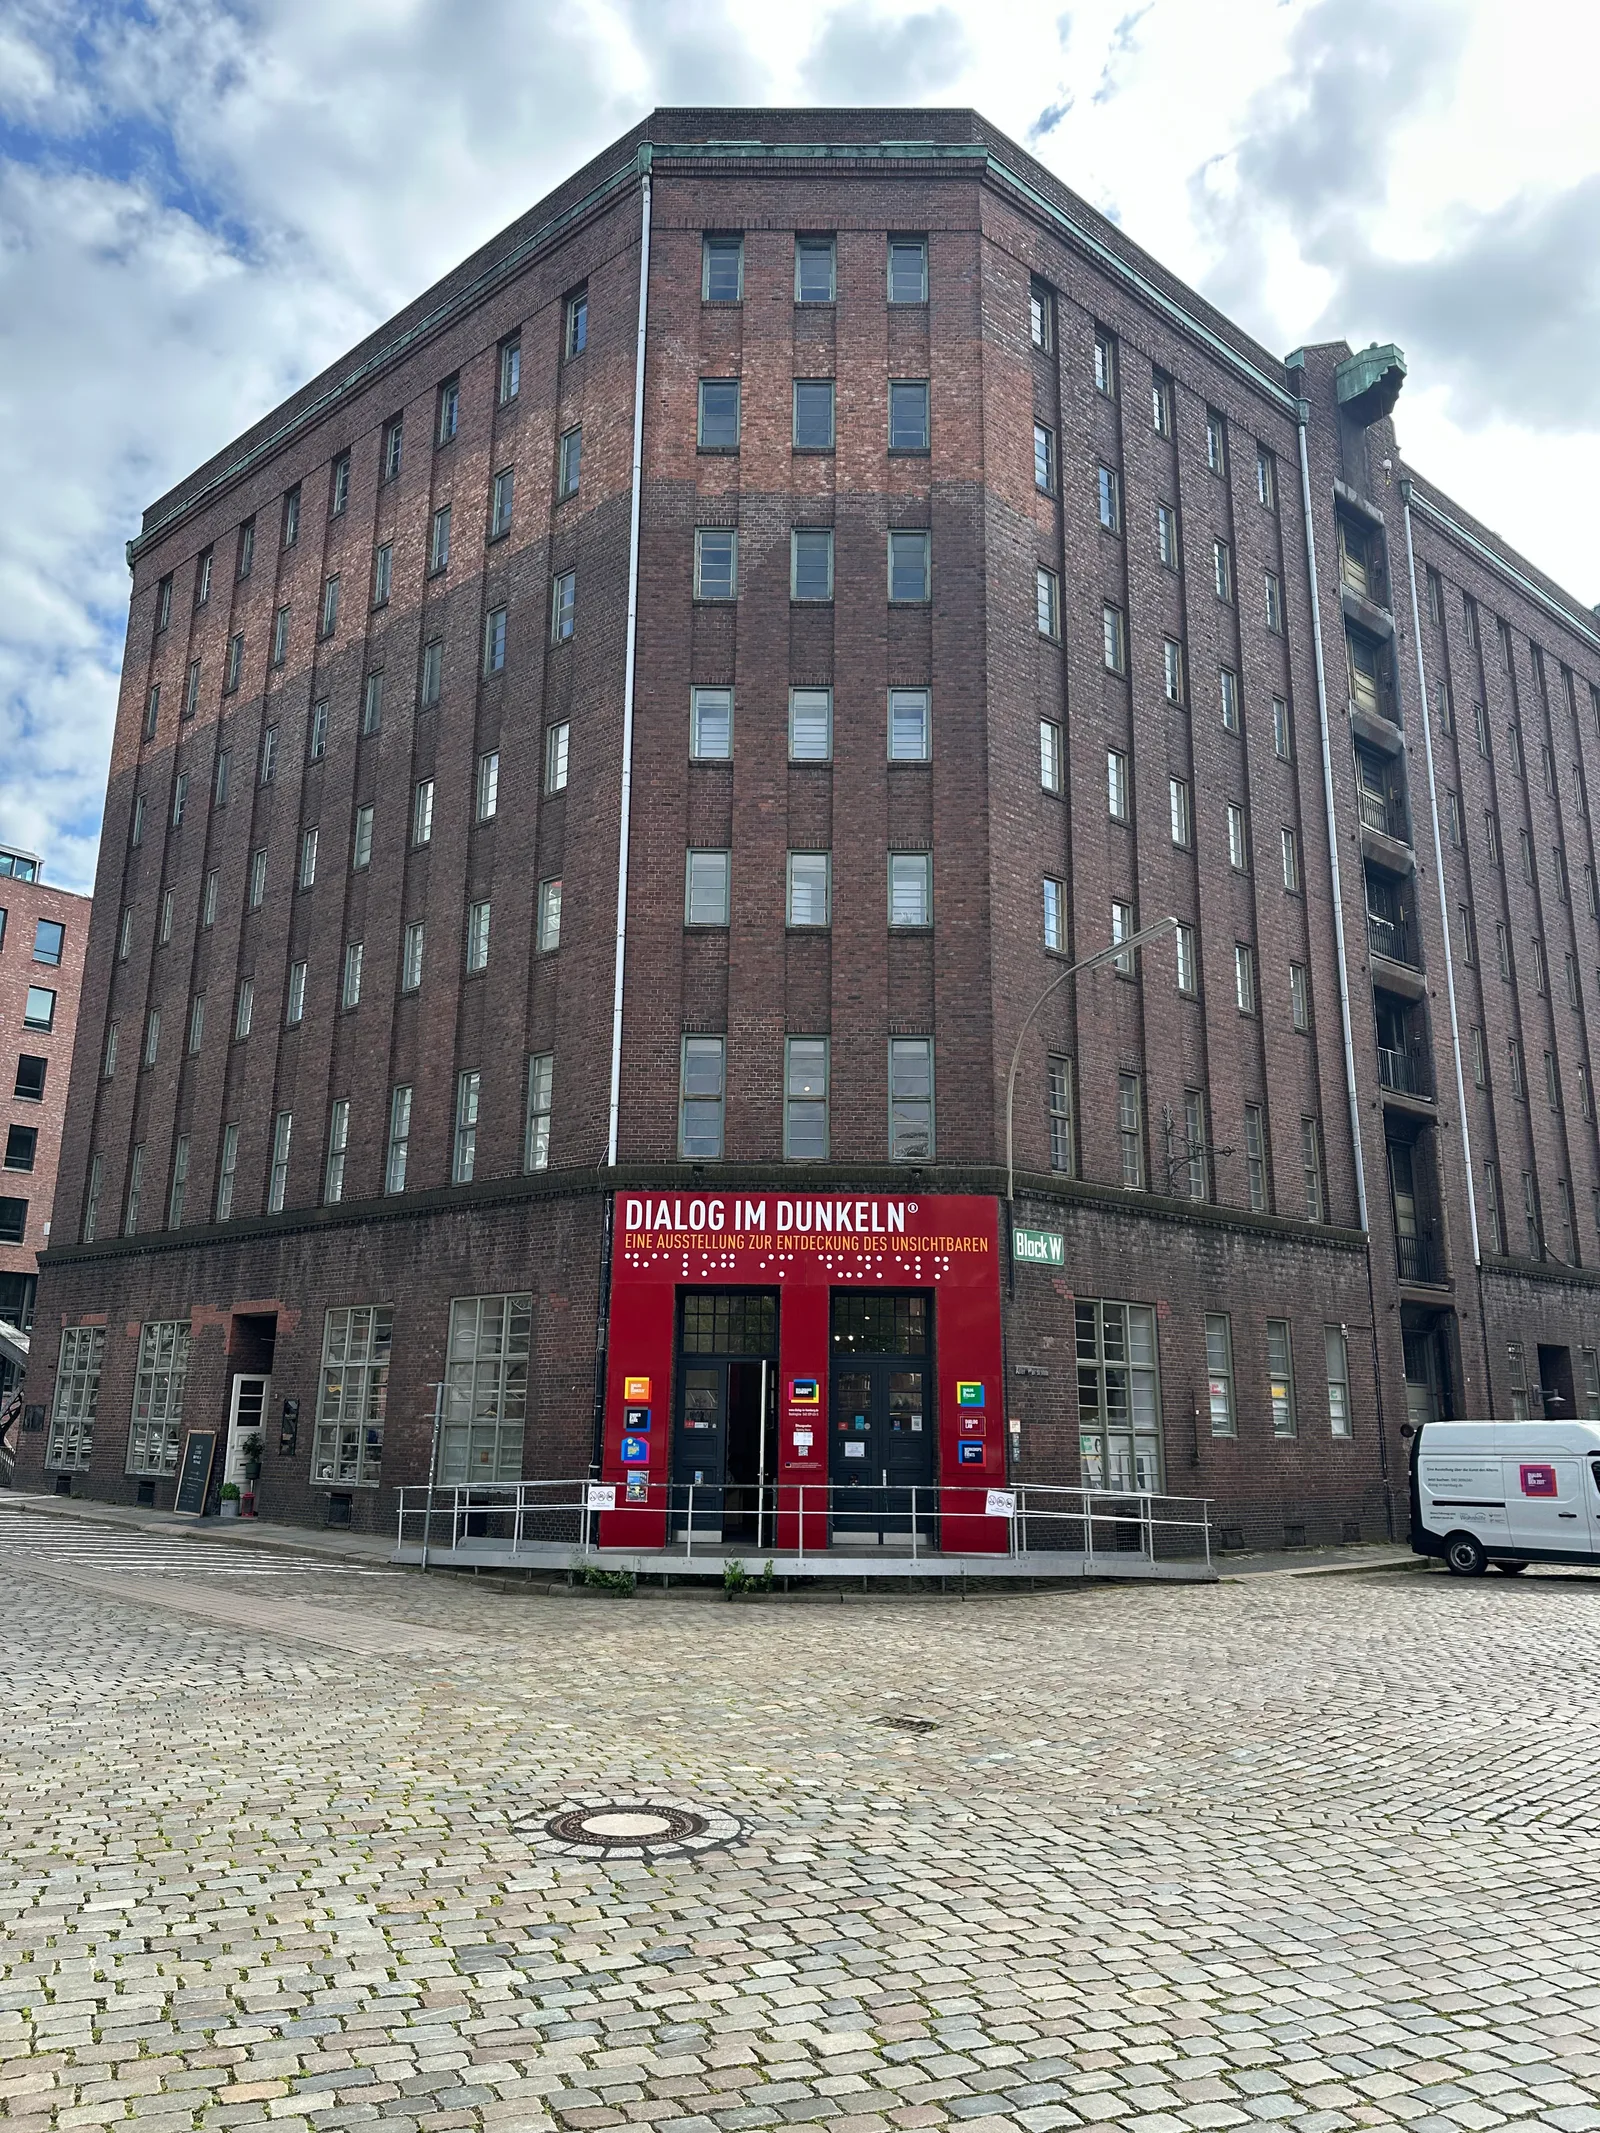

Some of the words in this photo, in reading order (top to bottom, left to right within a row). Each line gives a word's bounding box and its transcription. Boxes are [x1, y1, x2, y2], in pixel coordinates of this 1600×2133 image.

[625, 1199, 725, 1231] DIALOG
[734, 1200, 766, 1231] IM
[625, 1234, 653, 1249] EINE
[656, 1234, 745, 1250] AUSSTELLUNG
[748, 1234, 772, 1250] ZUR
[776, 1235, 860, 1251] ENTDECKUNG
[863, 1236, 888, 1251] DES
[891, 1236, 989, 1253] UNSICHTBAREN
[1016, 1231, 1049, 1259] Block
[1048, 1236, 1062, 1261] W
